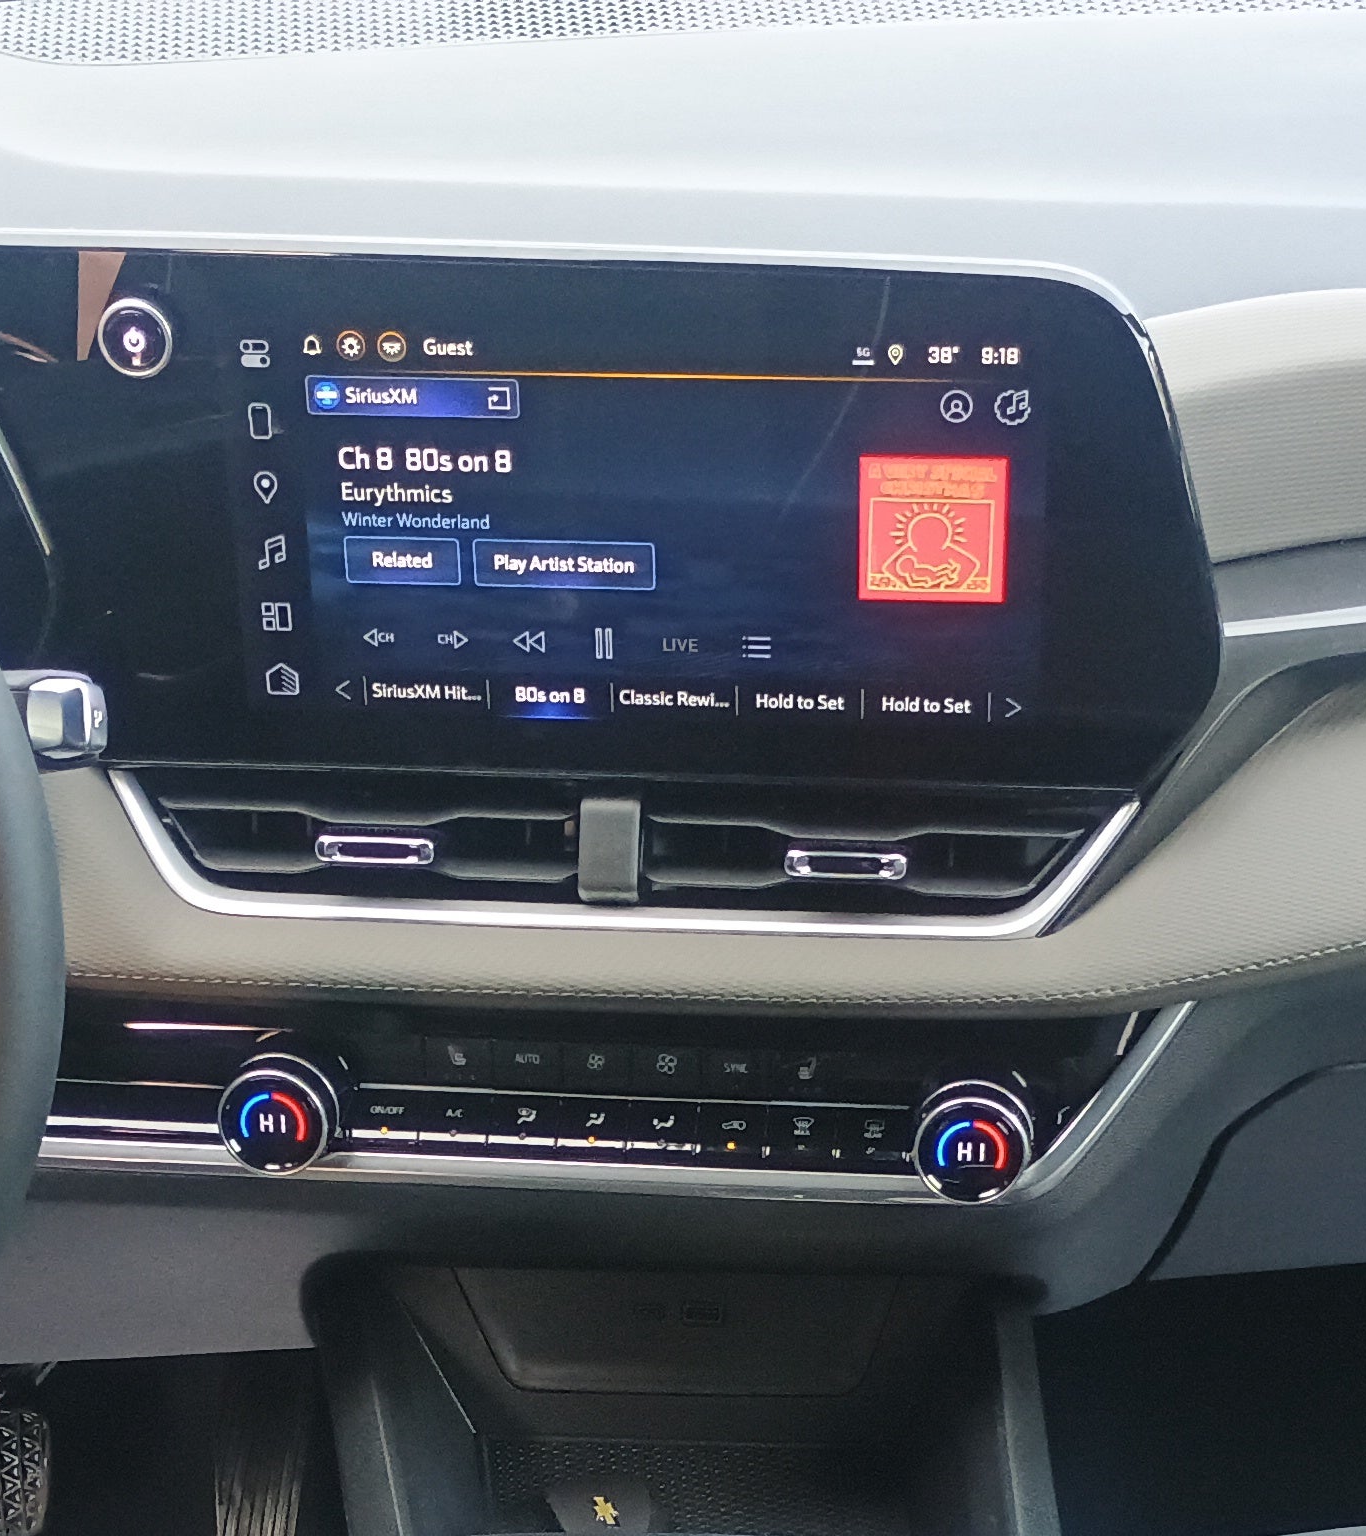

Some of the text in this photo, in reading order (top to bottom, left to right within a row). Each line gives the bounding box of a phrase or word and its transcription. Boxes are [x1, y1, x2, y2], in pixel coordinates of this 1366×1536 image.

[424, 339, 474, 356] Guest
[982, 347, 1019, 365] 9:18
[345, 387, 417, 405] SiriusXM
[338, 447, 512, 473] Ch 8 80s on 8
[341, 482, 453, 506] Eurythmics
[342, 512, 490, 530] Winter Wonderland
[372, 552, 433, 569] Related
[494, 554, 635, 575] Play Artist Station
[662, 638, 699, 653] LIVE
[372, 682, 441, 699] SiriusXM
[515, 687, 585, 703] 80s on 8
[619, 689, 673, 706] Classic
[755, 693, 844, 711] Hold to Set
[882, 696, 971, 714] Hold to Set
[446, 1107, 464, 1118] A/C
